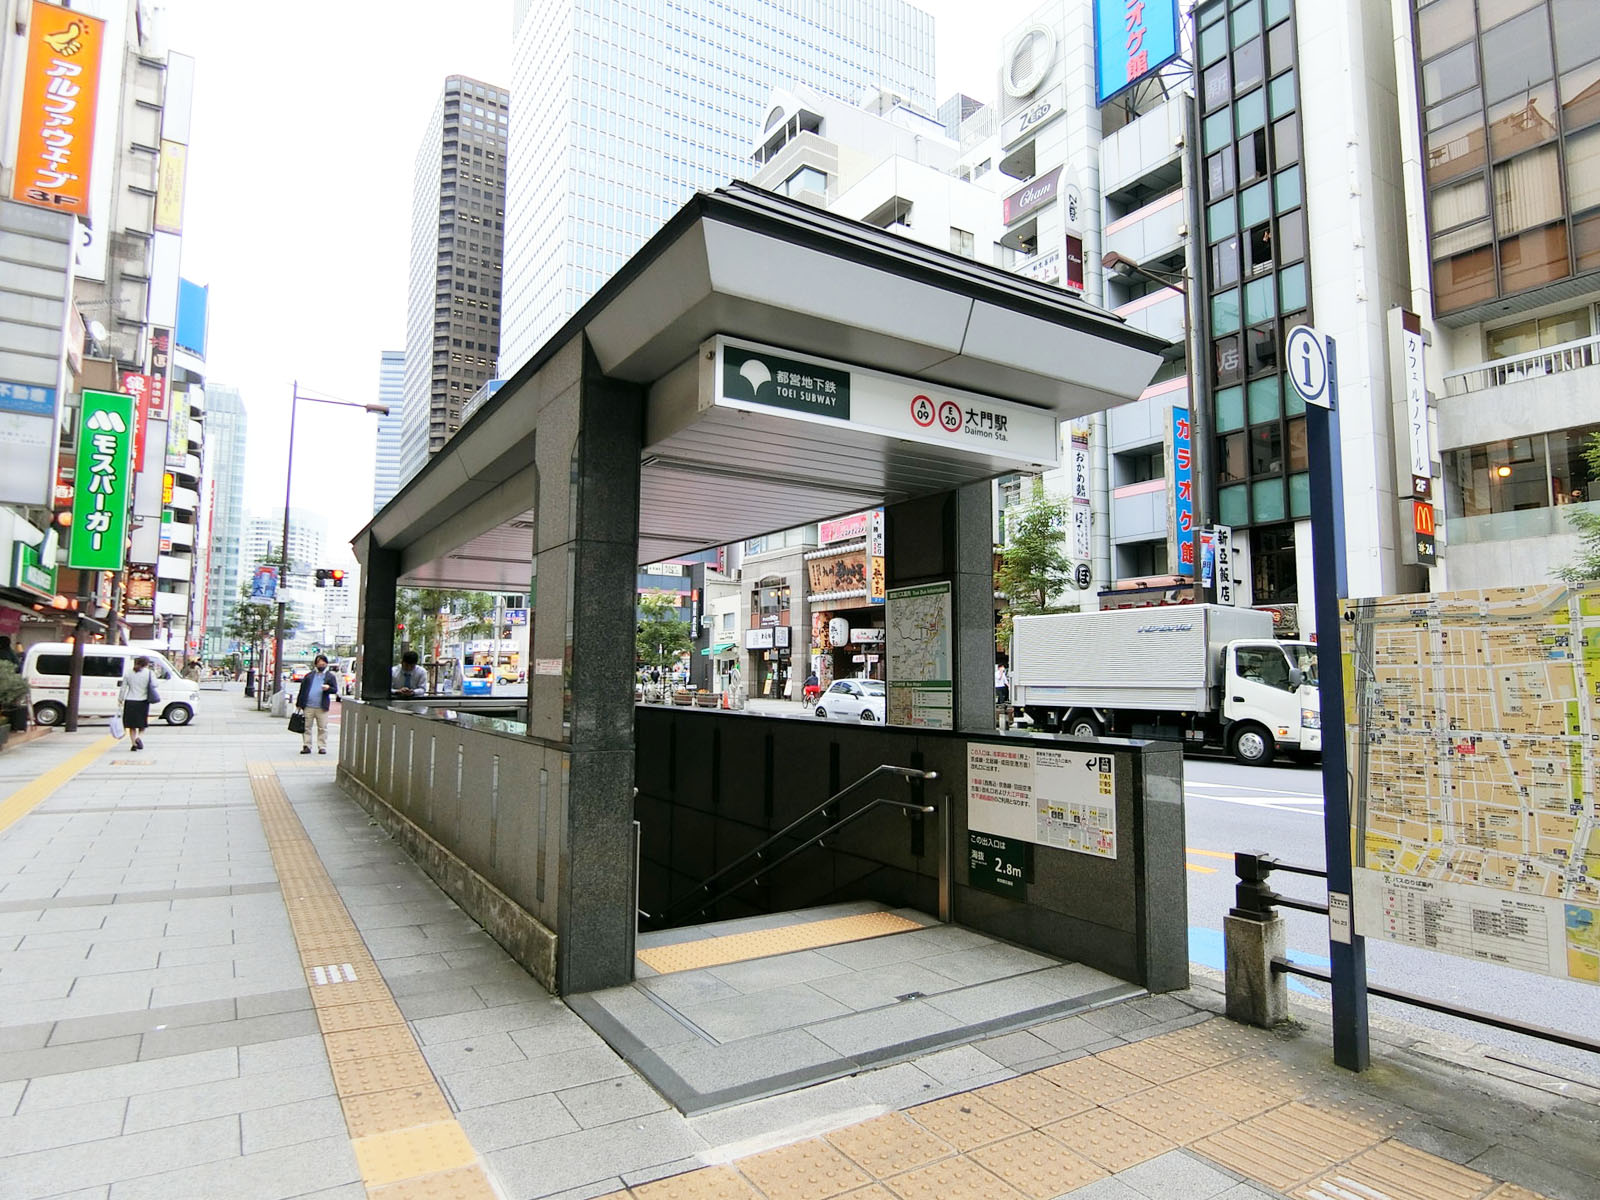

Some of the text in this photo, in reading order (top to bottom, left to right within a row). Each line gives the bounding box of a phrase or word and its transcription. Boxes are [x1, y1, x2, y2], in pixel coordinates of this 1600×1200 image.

[1124, 0, 1149, 82] オケ館
[26, 188, 79, 204] 3F
[776, 369, 836, 394] 都営地下鉄
[776, 386, 836, 407] TOEI SUBWAY
[918, 400, 927, 409] A
[1408, 337, 1424, 471] カフェルノアール
[915, 409, 930, 422] 09
[948, 406, 954, 415] E
[945, 414, 957, 427] 20
[965, 408, 1008, 432] 大門駅
[964, 425, 1009, 443] Daimon Sta.
[85, 433, 117, 551] モスバーガー
[1415, 478, 1427, 493] 2F
[970, 834, 1006, 849] この出入口は
[995, 857, 1022, 878] 2.8m
